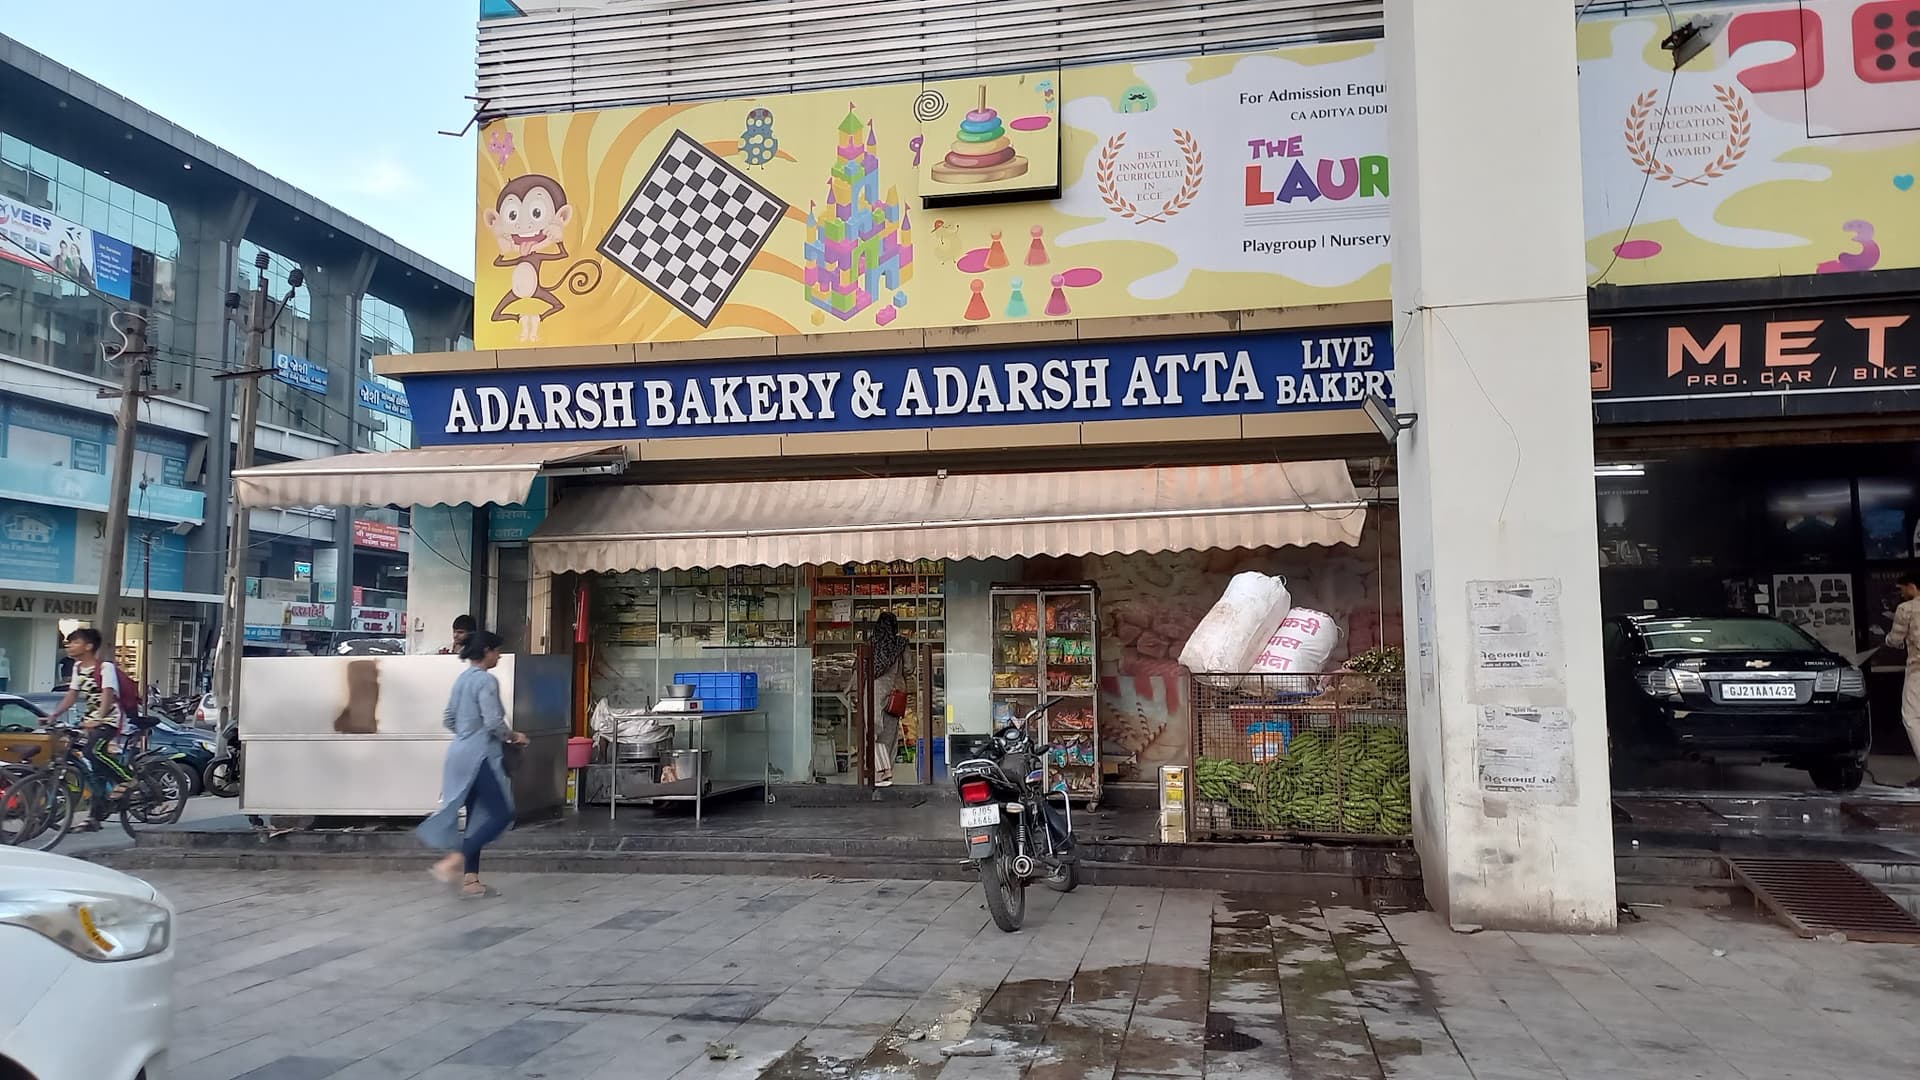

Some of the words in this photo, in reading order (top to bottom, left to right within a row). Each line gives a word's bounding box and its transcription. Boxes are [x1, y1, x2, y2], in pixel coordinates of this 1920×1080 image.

[1240, 92, 1263, 104] For
[1268, 86, 1341, 102] Admission
[1290, 111, 1306, 121] CA
[1310, 108, 1355, 119] ADITYA
[1654, 103, 1720, 117] NATIONAL
[1650, 117, 1725, 131] EDUCATION
[1649, 131, 1727, 145] EXCELLENCE
[1248, 135, 1304, 159] THE
[1666, 146, 1711, 158] AWARD
[1137, 151, 1162, 160] BEST
[1119, 160, 1182, 171] INNOVATIVE
[1116, 170, 1184, 182] CURRICULUM
[1144, 181, 1155, 190] IN
[1137, 191, 1162, 201] ECCE
[11, 204, 52, 231] VEER
[1243, 237, 1317, 255] Playgroup
[1330, 232, 1391, 248] Nursery
[1302, 336, 1374, 370] LIVE
[1667, 315, 1910, 378] MET
[1687, 373, 1747, 387] PRO.
[1760, 370, 1812, 384] CAR
[1853, 365, 1917, 380] BIKE
[445, 381, 636, 433] ADARSH
[644, 372, 841, 427] BAKERY
[851, 369, 887, 418] &
[895, 358, 1111, 416] ADARSH
[1121, 350, 1264, 407] ATTA
[1729, 684, 1795, 697] GJ21AA1432
